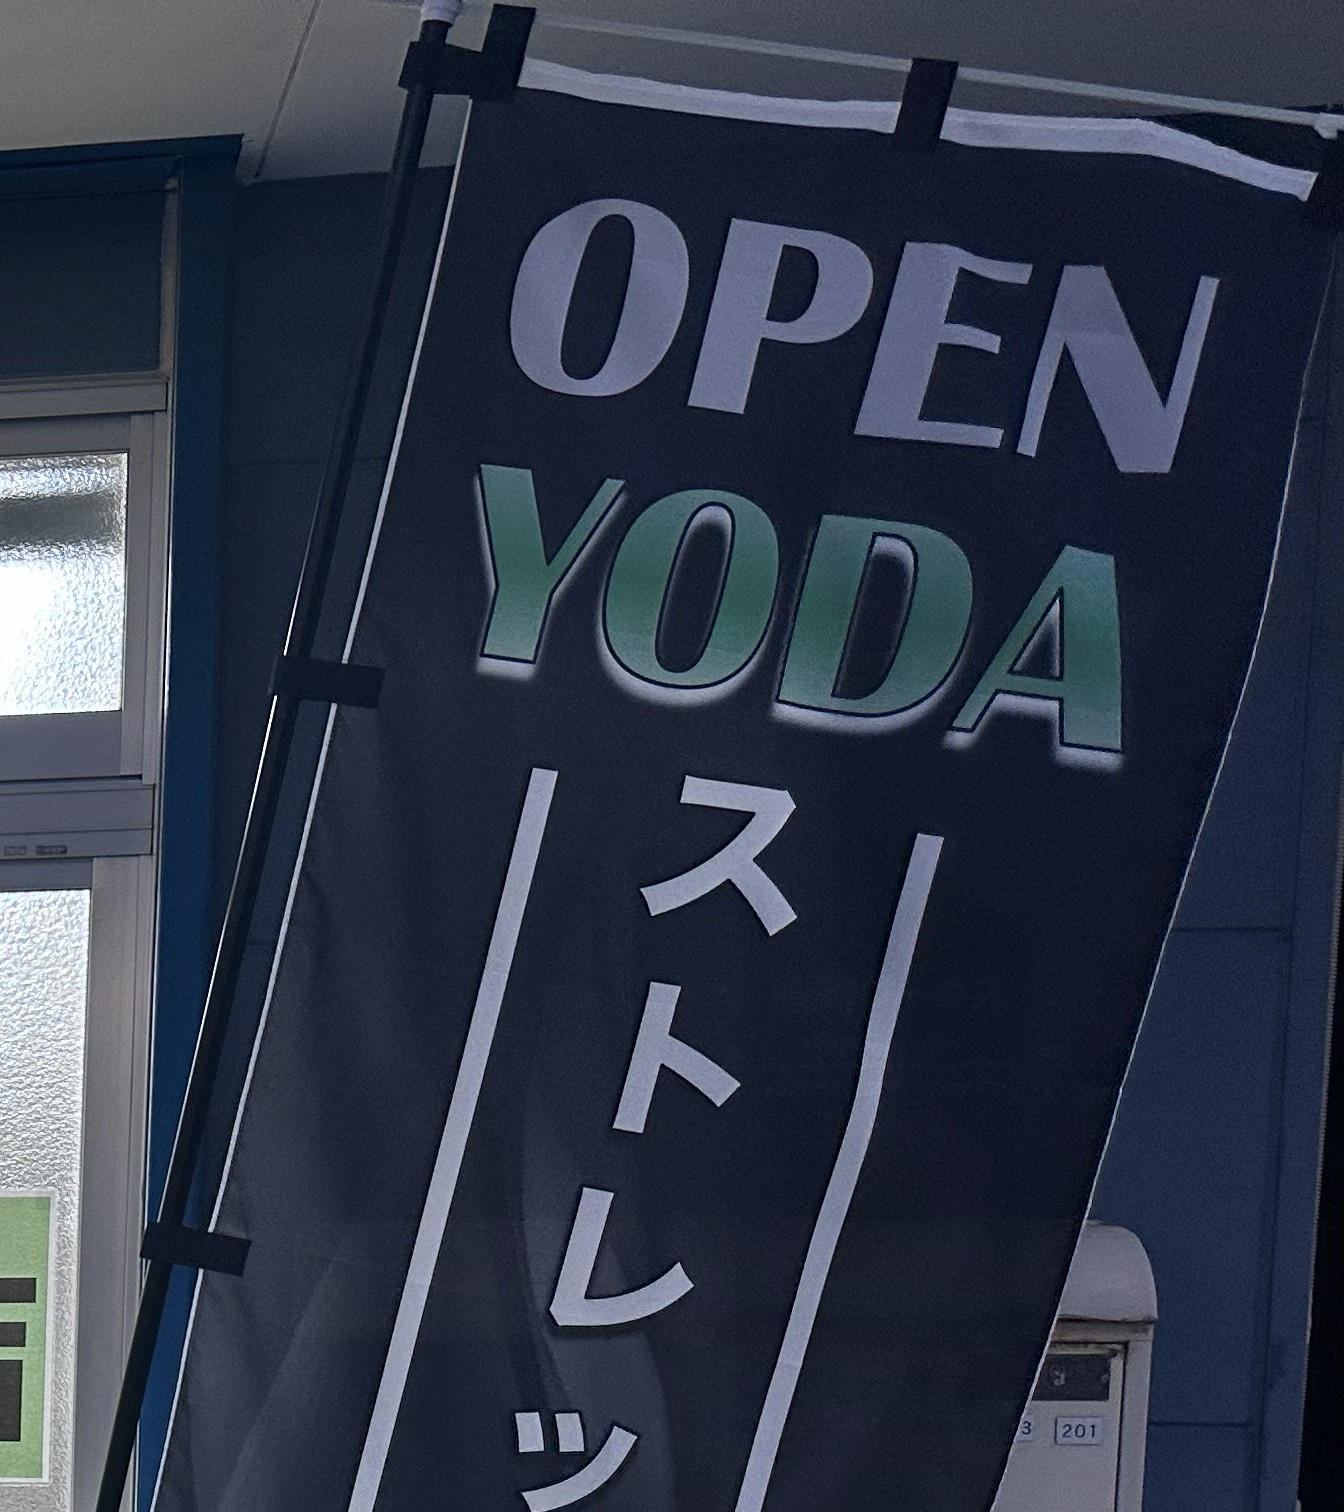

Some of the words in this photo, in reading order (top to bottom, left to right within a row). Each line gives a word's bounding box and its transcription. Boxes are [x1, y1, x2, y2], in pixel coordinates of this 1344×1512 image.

[511, 198, 1220, 473] OPEN
[475, 464, 1124, 770] YODA
[1062, 1423, 1096, 1438] 201
